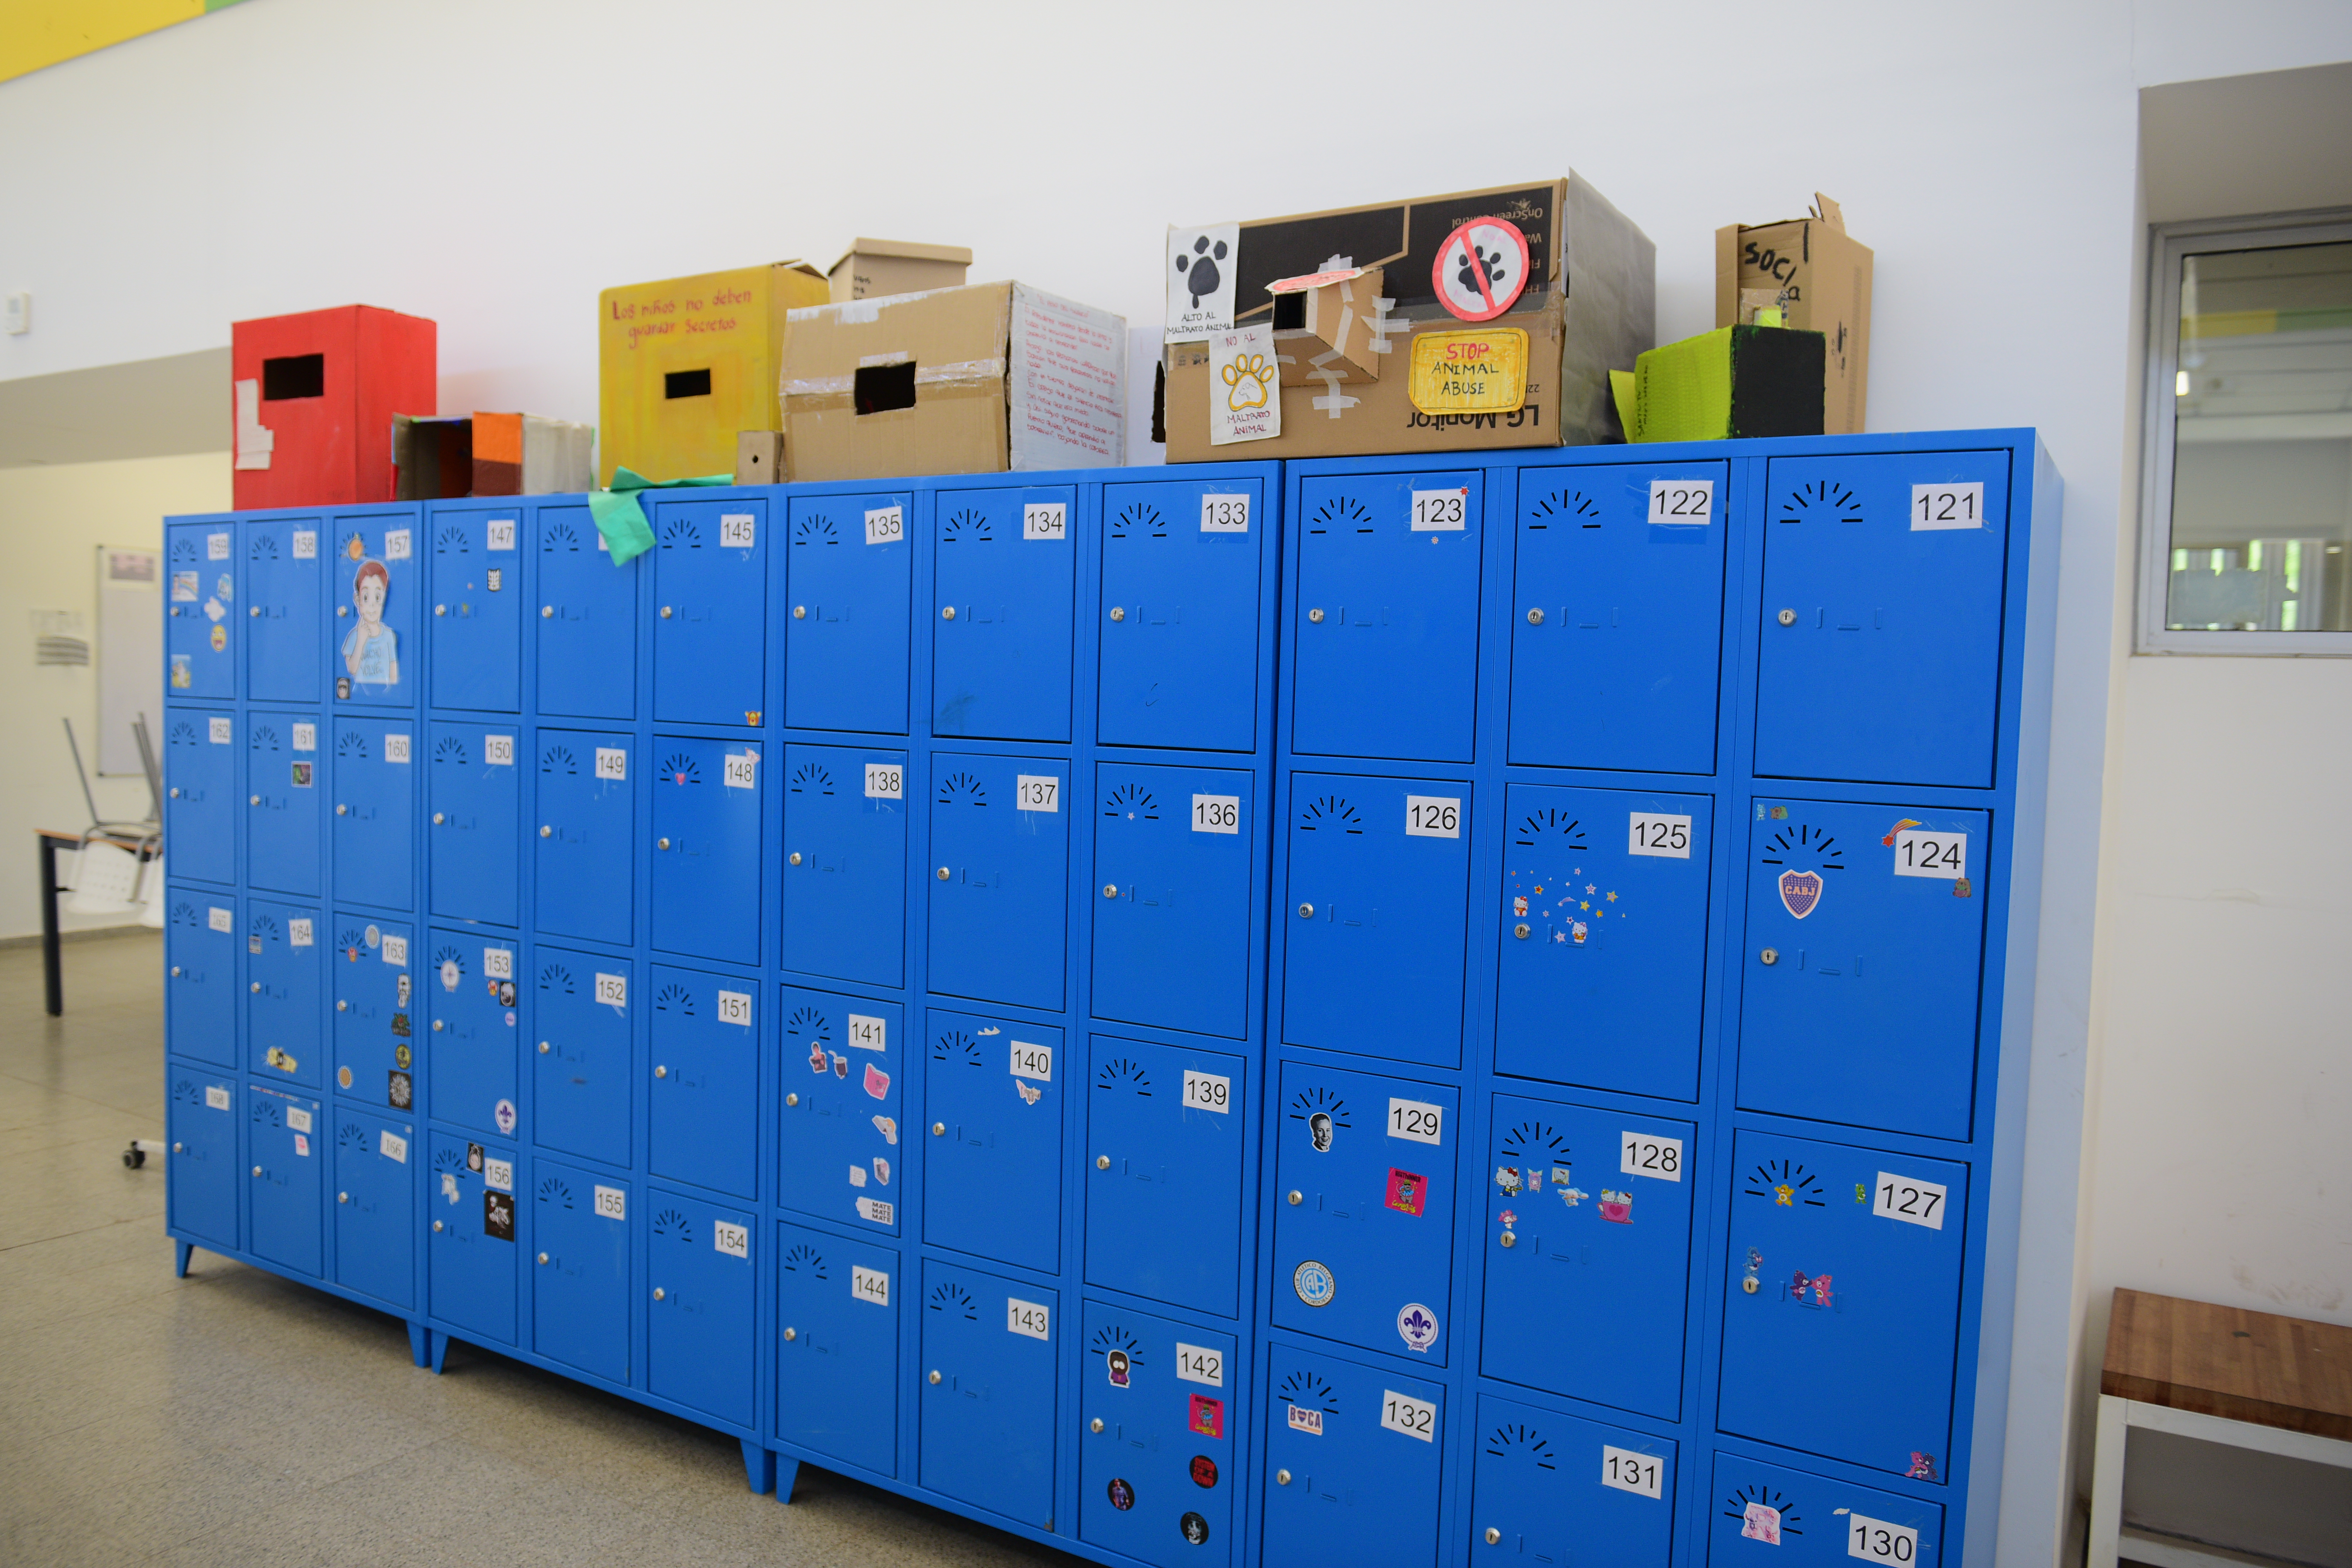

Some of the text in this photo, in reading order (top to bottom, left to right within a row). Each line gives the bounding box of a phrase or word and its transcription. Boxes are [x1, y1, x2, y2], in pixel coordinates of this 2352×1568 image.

[1452, 214, 1490, 229] ntrol
[613, 287, 752, 320] Los niños no deben
[1181, 311, 1216, 322] ALTO AL
[1167, 322, 1234, 335] MALTRATO ANIMAL
[1226, 334, 1256, 347] NO AL
[1446, 342, 1490, 360] STOP
[1431, 361, 1499, 378] ANIMAL
[1441, 380, 1485, 396] ABUSE
[1227, 410, 1271, 424] MALTRATO
[1407, 404, 1539, 431] LG Monitor
[1233, 424, 1267, 436] ANIMAL
[1416, 500, 1462, 522] 123
[1655, 490, 1708, 515] 122
[1918, 492, 1973, 521] 121
[1028, 511, 1062, 532] 134
[1206, 502, 1245, 525] 133
[490, 526, 512, 543] 147
[724, 522, 751, 540] 145
[869, 514, 900, 537] 135
[209, 536, 228, 554] 159
[295, 536, 315, 555] 158
[387, 535, 408, 552] 157
[210, 723, 230, 740] 162
[295, 729, 313, 745] 161
[387, 739, 409, 757] 160
[487, 741, 510, 759] 150
[599, 755, 623, 774] 149
[727, 762, 752, 782] 148
[869, 771, 899, 792] 138
[1021, 783, 1056, 804] 137
[1196, 802, 1236, 826] 136
[1411, 804, 1456, 830] 126
[1635, 821, 1686, 849] 125
[1902, 840, 1961, 869] 124
[1785, 885, 1815, 896] CABJ
[212, 914, 227, 928] 165
[291, 925, 311, 941] 164
[384, 942, 405, 960] 163
[487, 955, 511, 973] 153
[599, 980, 623, 1001] 152
[721, 998, 747, 1019] 151
[852, 1022, 880, 1044] 141
[1014, 1049, 1048, 1074] 140
[210, 1092, 224, 1106] 168
[1188, 1079, 1226, 1105] 139
[292, 1112, 306, 1127] 167
[1393, 1107, 1438, 1136] 129
[385, 1138, 402, 1156] 166
[1627, 1141, 1677, 1172] 128
[487, 1165, 511, 1185] 156
[597, 1193, 622, 1213] 155
[872, 1202, 891, 1211] MATE
[1882, 1184, 1941, 1218] 127
[872, 1208, 891, 1217] MATE
[872, 1213, 891, 1223] MATE
[718, 1228, 745, 1251] 154
[856, 1274, 885, 1298] 144
[1297, 1263, 1316, 1276] ATLETICO
[1318, 1265, 1332, 1294] BELGRANO
[1305, 1297, 1329, 1305] CORDOBA
[1012, 1307, 1046, 1332] 143
[1181, 1352, 1219, 1379] 142
[1290, 1406, 1320, 1428] BCA
[1388, 1401, 1431, 1434] 132
[1608, 1456, 1654, 1489] 131
[1856, 1525, 1912, 1562] 130
